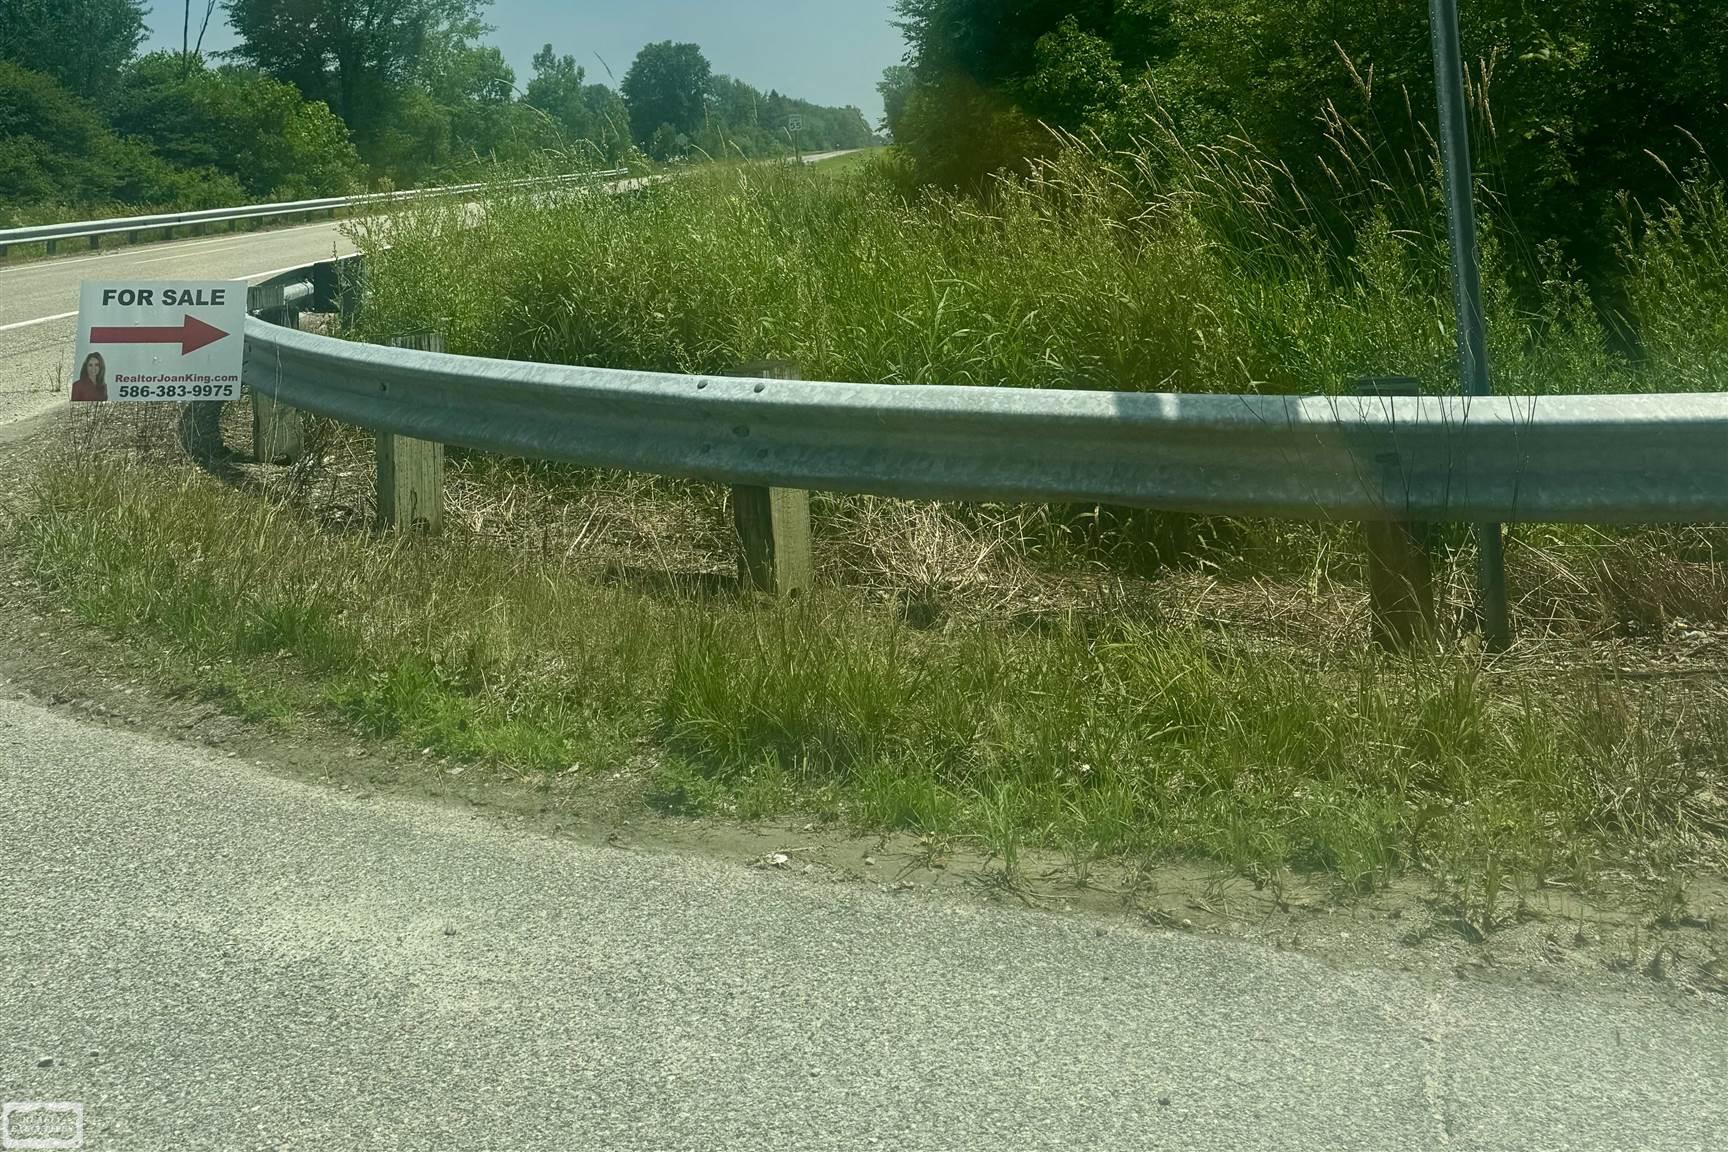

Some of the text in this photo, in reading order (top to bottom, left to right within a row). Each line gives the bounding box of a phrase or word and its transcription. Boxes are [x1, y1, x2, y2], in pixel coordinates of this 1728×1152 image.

[102, 289, 226, 306] FOR SALE
[115, 374, 238, 384] RealtorJoanKing.com
[119, 385, 233, 397] 586-383-9975
